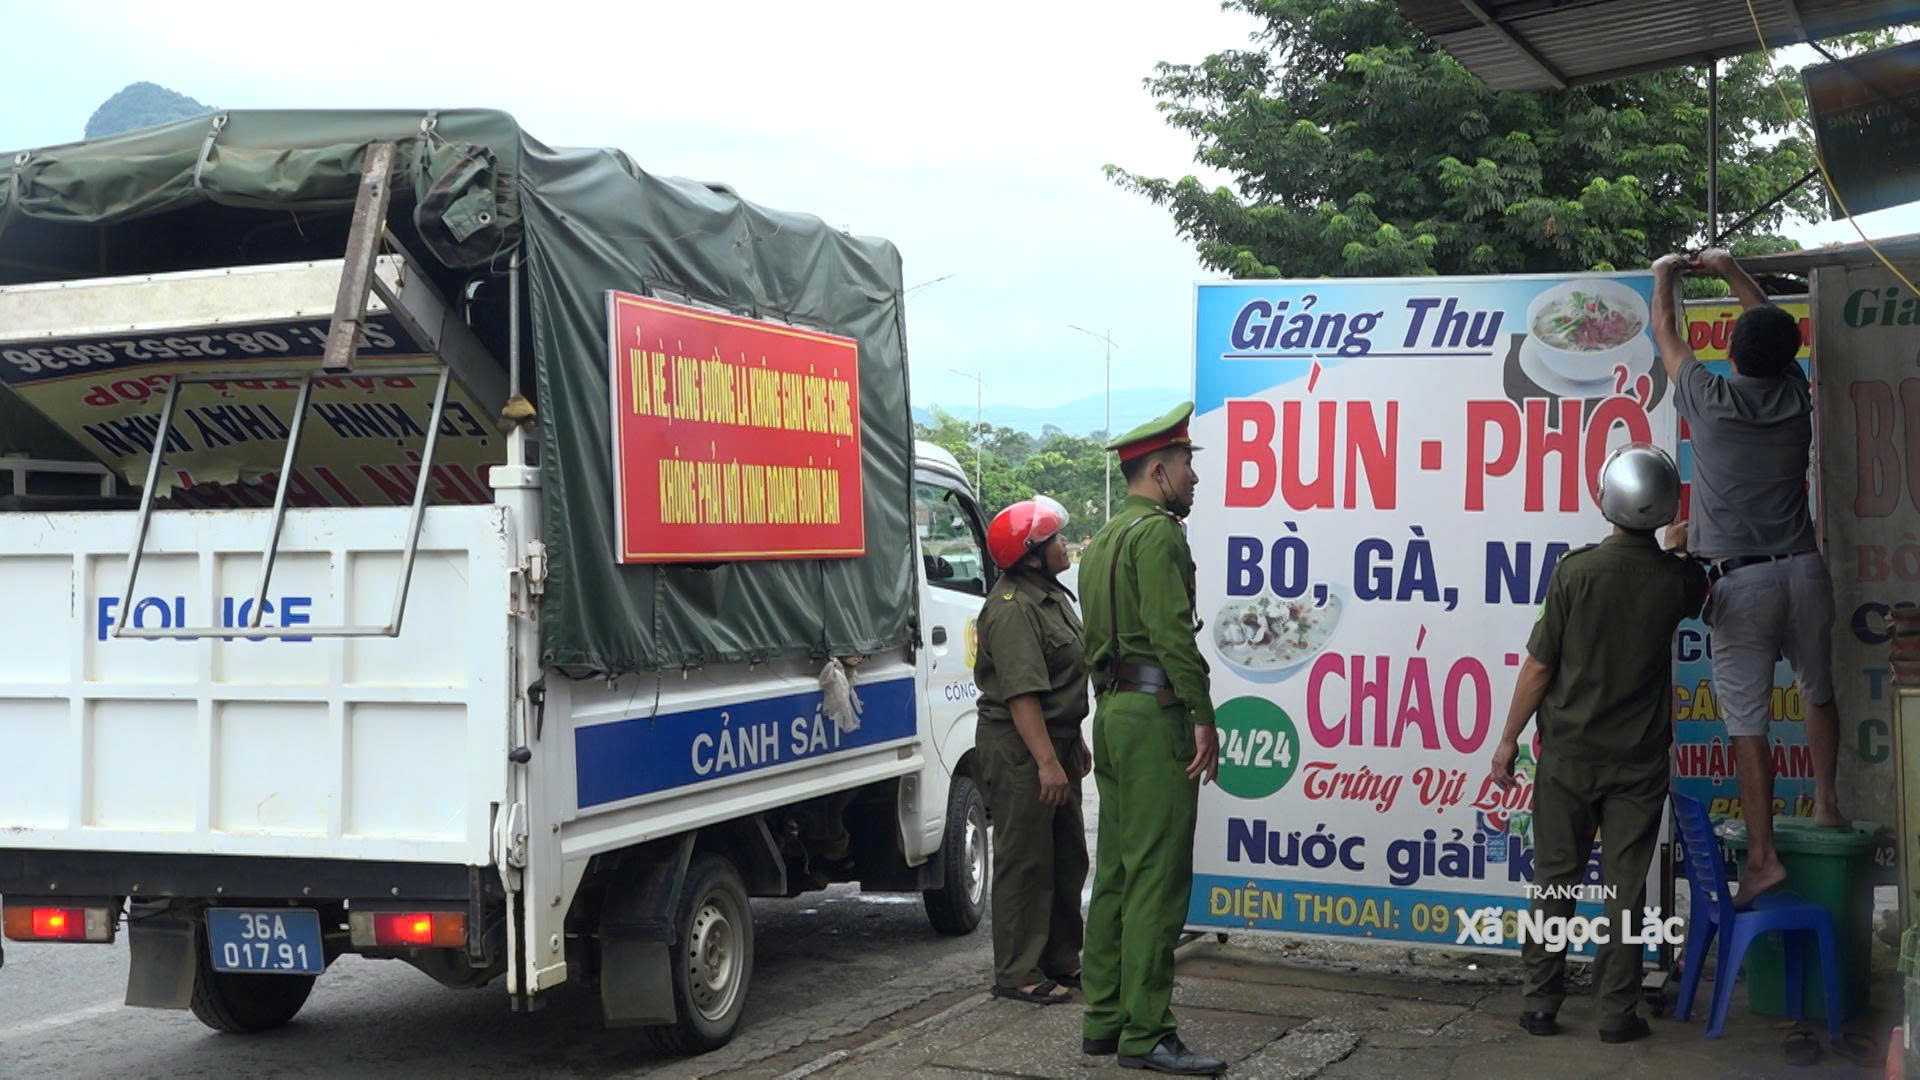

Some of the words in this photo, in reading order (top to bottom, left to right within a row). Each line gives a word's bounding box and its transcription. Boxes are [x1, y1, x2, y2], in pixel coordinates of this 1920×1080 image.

[1229, 294, 1383, 356] Giảng
[1403, 297, 1505, 349] Thu
[1224, 361, 1399, 511] BÚN
[1225, 521, 1328, 607] BÒ,
[1354, 525, 1459, 610] GÀ,
[98, 597, 312, 642] POLICE
[945, 681, 976, 701] CÔNG
[1307, 623, 1491, 754] CHÁO
[692, 712, 778, 775] CẢNH
[791, 704, 843, 756] SÁT
[1215, 728, 1291, 768] 24/24
[1769, 737, 1815, 778] ÀM
[1303, 762, 1403, 813] Trứng
[1412, 767, 1467, 813] Vịt
[1227, 817, 1365, 871] Nước
[1386, 828, 1486, 886] giải
[239, 913, 287, 940] 36A
[1210, 881, 1283, 927] ĐIỆN
[1294, 893, 1400, 936] THOẠI:
[224, 942, 308, 970] 017.91
